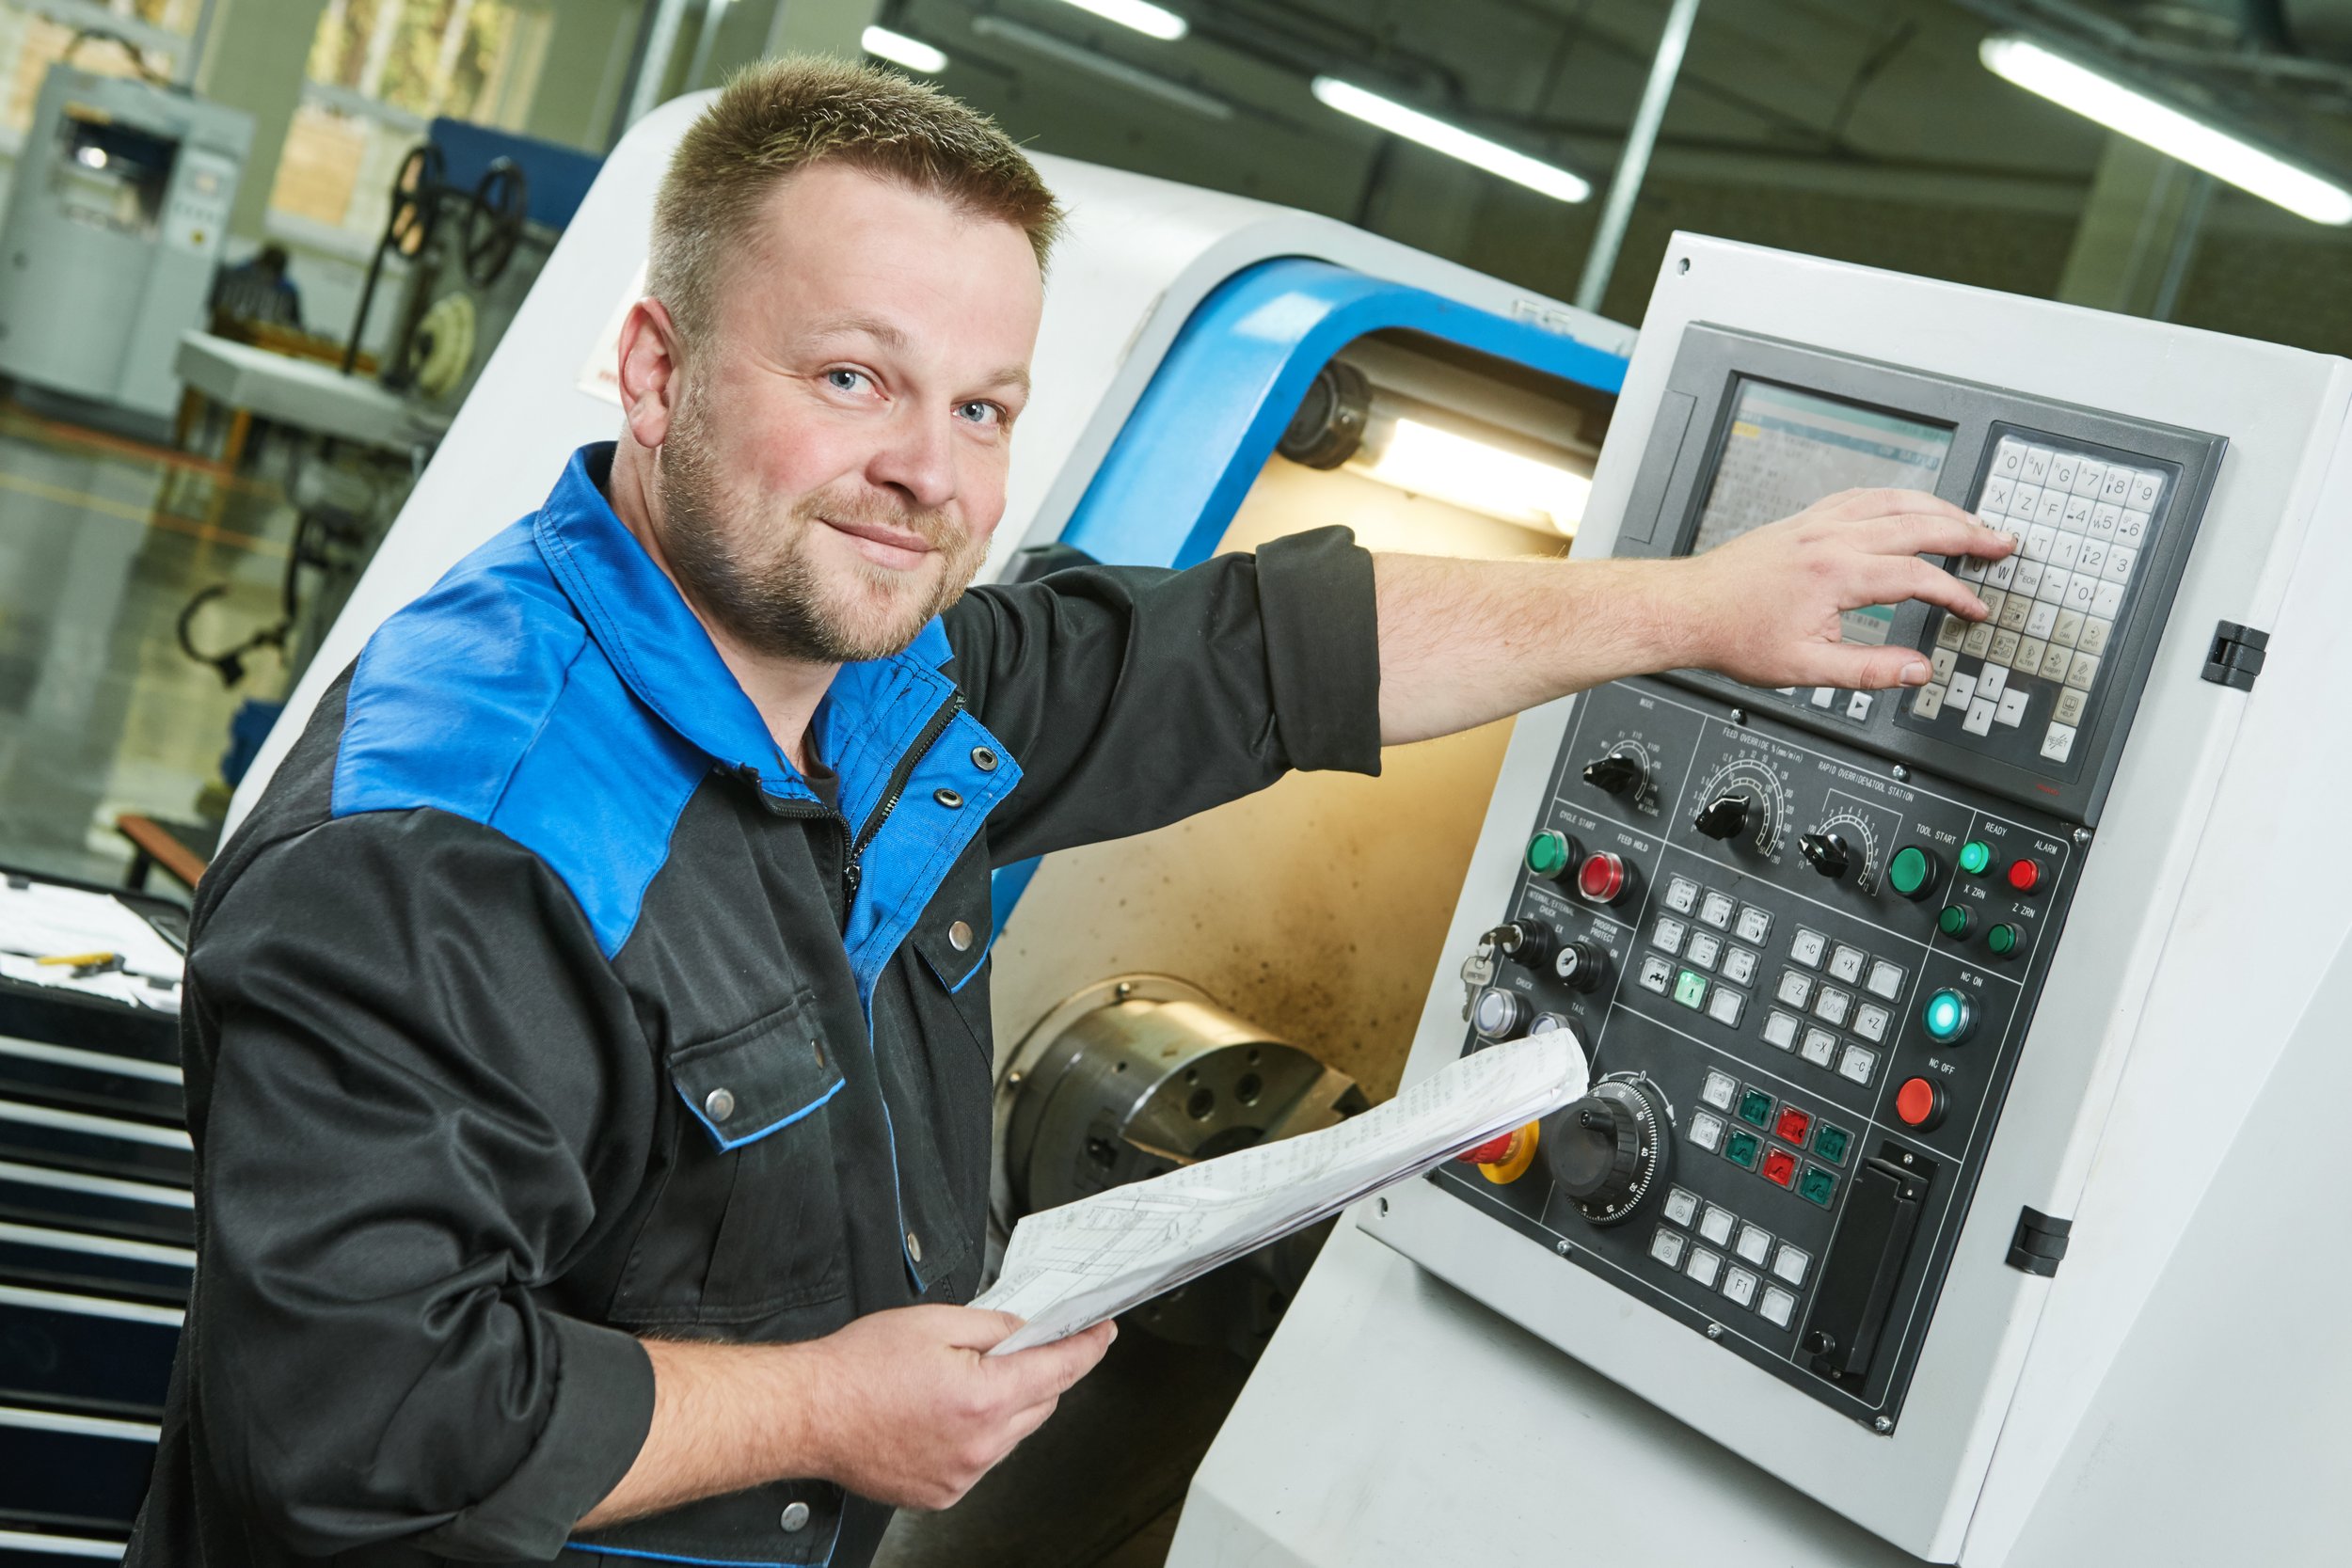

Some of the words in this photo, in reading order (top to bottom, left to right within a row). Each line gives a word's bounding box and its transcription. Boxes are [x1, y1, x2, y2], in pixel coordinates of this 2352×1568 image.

[2033, 462, 2044, 476] N
[2059, 469, 2071, 482] G
[2088, 473, 2099, 486] 7
[2114, 481, 2125, 494] 8
[2141, 487, 2153, 500] 9
[1995, 491, 2007, 504] X
[2021, 497, 2032, 511] Z
[2047, 504, 2058, 516] F
[2075, 510, 2087, 523] 4
[2103, 516, 2114, 530] 5
[2129, 523, 2140, 536] 6
[2039, 539, 2047, 552] T
[2066, 545, 2072, 558] 1
[2090, 552, 2102, 565] 2
[2117, 559, 2128, 572] 3
[1997, 566, 2010, 580] W
[2022, 575, 2038, 586] EOB
[2083, 638, 2100, 647] INPUT
[2018, 658, 2035, 667] ALTER
[2043, 667, 2061, 675] INSERT
[2071, 673, 2087, 684] DELETE
[1639, 697, 1655, 710] MODE
[2060, 709, 2074, 718] HELP
[1632, 730, 1643, 741] X10
[1723, 726, 1739, 739] FEED
[1740, 733, 1770, 750] OVERRIDE
[2047, 736, 2067, 748] RESET
[1647, 741, 1661, 752] X100
[1739, 750, 1746, 758] 20
[1818, 761, 1836, 775] RAPID
[1887, 785, 1915, 802] STATION
[1829, 809, 1835, 817] 2
[1838, 806, 1844, 815] 3
[1857, 809, 1862, 817] 5
[1559, 809, 1577, 824] CYCLE
[1578, 816, 1597, 832] START
[1870, 822, 1876, 831] 7
[1783, 822, 1792, 833] 500
[1807, 824, 1817, 834] 100
[1984, 821, 2008, 837] READY
[1915, 823, 1931, 838] TOOL
[1934, 832, 1957, 846] START
[1616, 833, 1632, 847] FEED
[1633, 839, 1649, 853] HOLD
[2034, 840, 2058, 856] ALARM
[1874, 847, 1879, 857] 9
[1872, 861, 1878, 870] 10
[1868, 872, 1874, 881] 11
[1863, 883, 1869, 892] 12
[1963, 884, 1970, 894] X
[1971, 887, 1987, 901] ZRN
[1539, 905, 1558, 919] CHUCK
[2011, 902, 2019, 913] Z
[2020, 905, 2036, 919] ZRN
[1555, 924, 1564, 935] EX
[1592, 917, 1618, 936] PROGRAM
[1590, 927, 1615, 944] PROTECT
[1610, 948, 1619, 959] ON
[1804, 943, 1817, 955] +C
[1843, 960, 1855, 972] +X
[1515, 977, 1534, 990] CHUCK
[1961, 971, 1970, 982] NC
[1973, 976, 1984, 988] ON
[1792, 984, 1804, 996] -Z
[1571, 1002, 1585, 1016] TAIL
[1867, 1018, 1880, 1030] +Z
[1815, 1041, 1827, 1053] -X
[1853, 1061, 1866, 1072] -C
[1929, 1057, 1940, 1069] NC
[1941, 1062, 1956, 1075] OFF
[1641, 1147, 1649, 1157] 40
[1629, 1181, 1638, 1193] 30
[1735, 1278, 1748, 1294] F1
